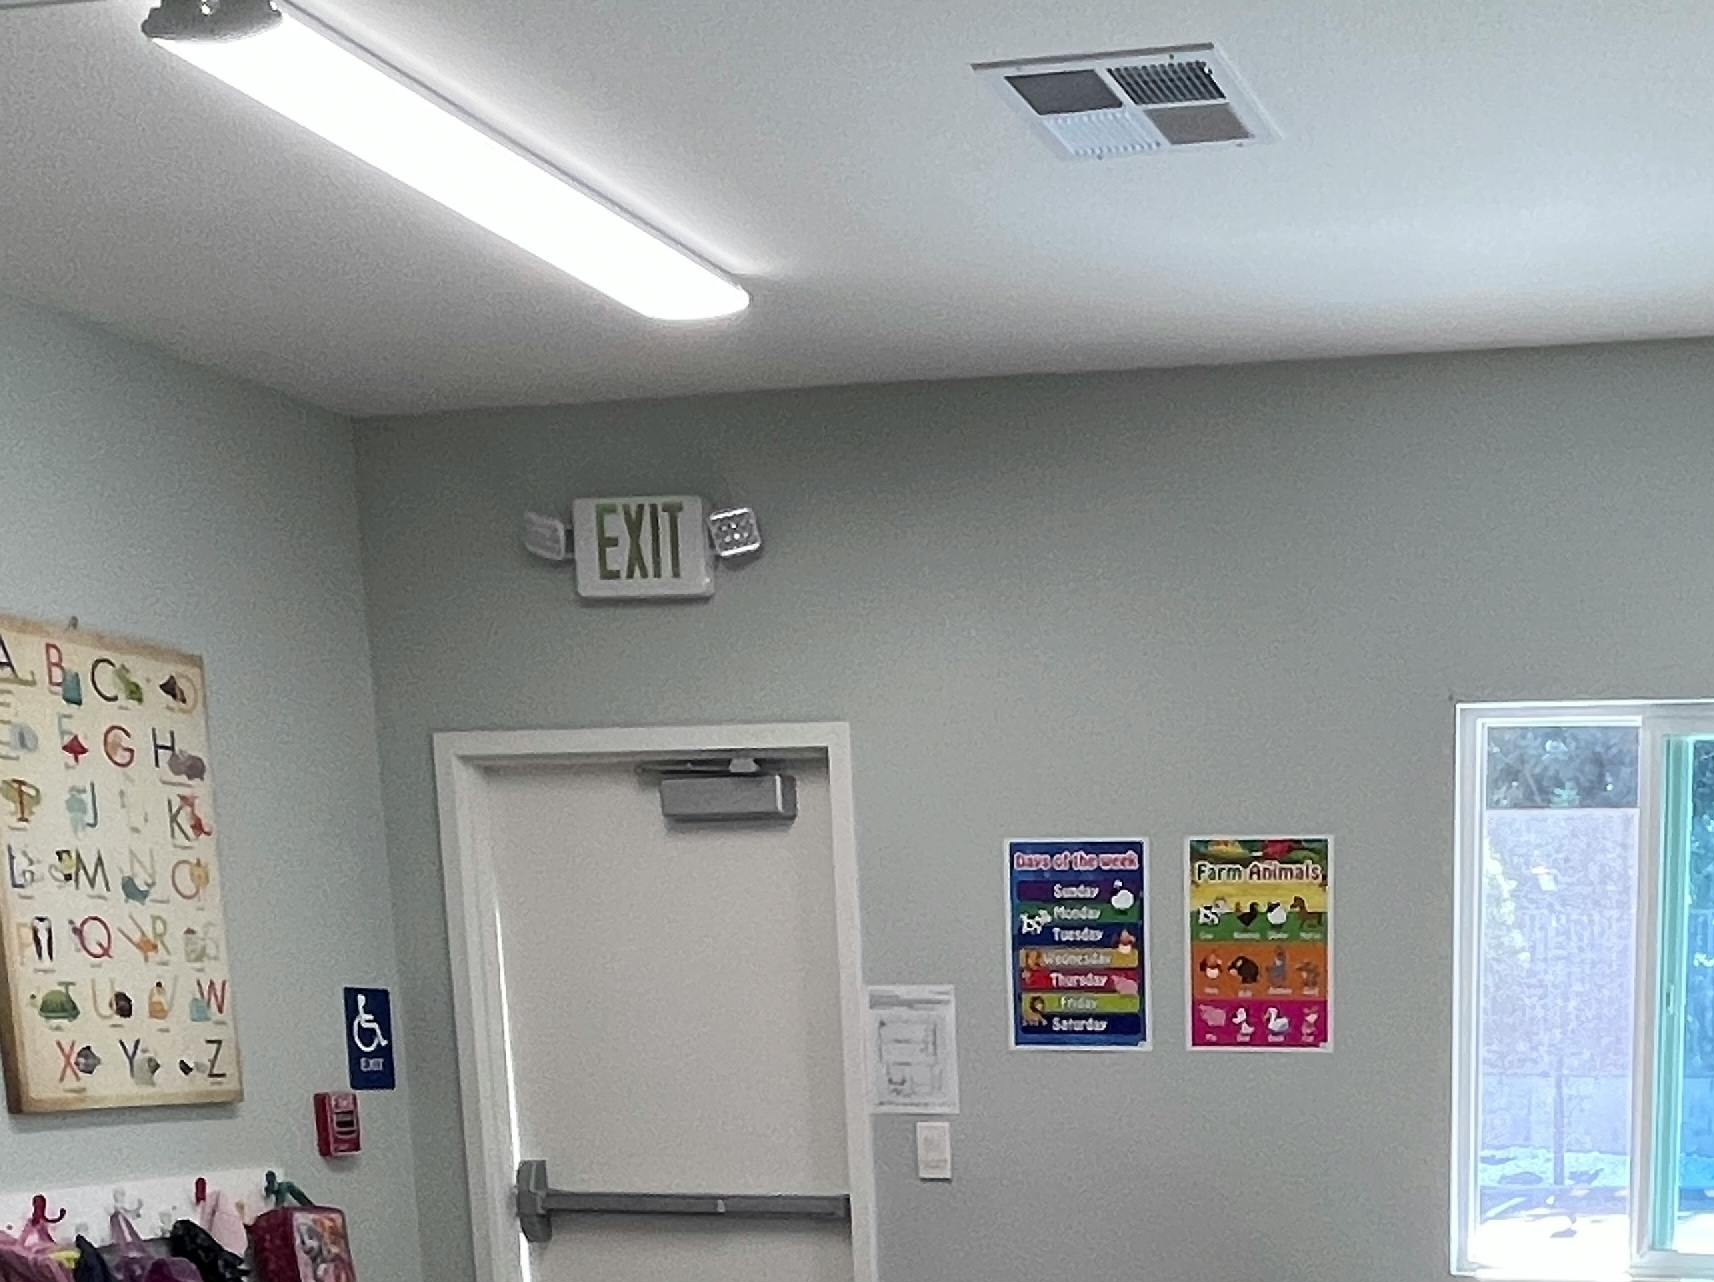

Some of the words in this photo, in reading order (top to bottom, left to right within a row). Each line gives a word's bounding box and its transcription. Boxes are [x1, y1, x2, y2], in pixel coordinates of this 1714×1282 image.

[596, 502, 683, 580] EXIT
[45, 642, 64, 687] B
[91, 657, 119, 703] C
[103, 725, 135, 768] G
[151, 726, 176, 769] H
[85, 780, 99, 829] J
[167, 797, 191, 842] K
[74, 848, 111, 893] M
[1014, 851, 1051, 870] Days
[1053, 851, 1070, 870] of
[1071, 850, 1098, 870] the
[1099, 850, 1139, 870] week
[1196, 862, 1243, 881] Farm
[1248, 860, 1321, 881] Animals
[1053, 884, 1099, 899] Sunday
[1053, 905, 1100, 919] Monday
[79, 915, 114, 959] Q
[151, 914, 171, 956] R
[1052, 926, 1103, 941] Tuesday
[1043, 951, 1111, 966] Wednesday
[1049, 972, 1108, 988] Thursday
[196, 978, 227, 1015] W
[1060, 995, 1097, 1011] Friday
[1051, 1017, 1108, 1031] Saturday
[55, 1039, 81, 1083] X
[118, 1038, 141, 1079] Y
[205, 1038, 227, 1079] Z
